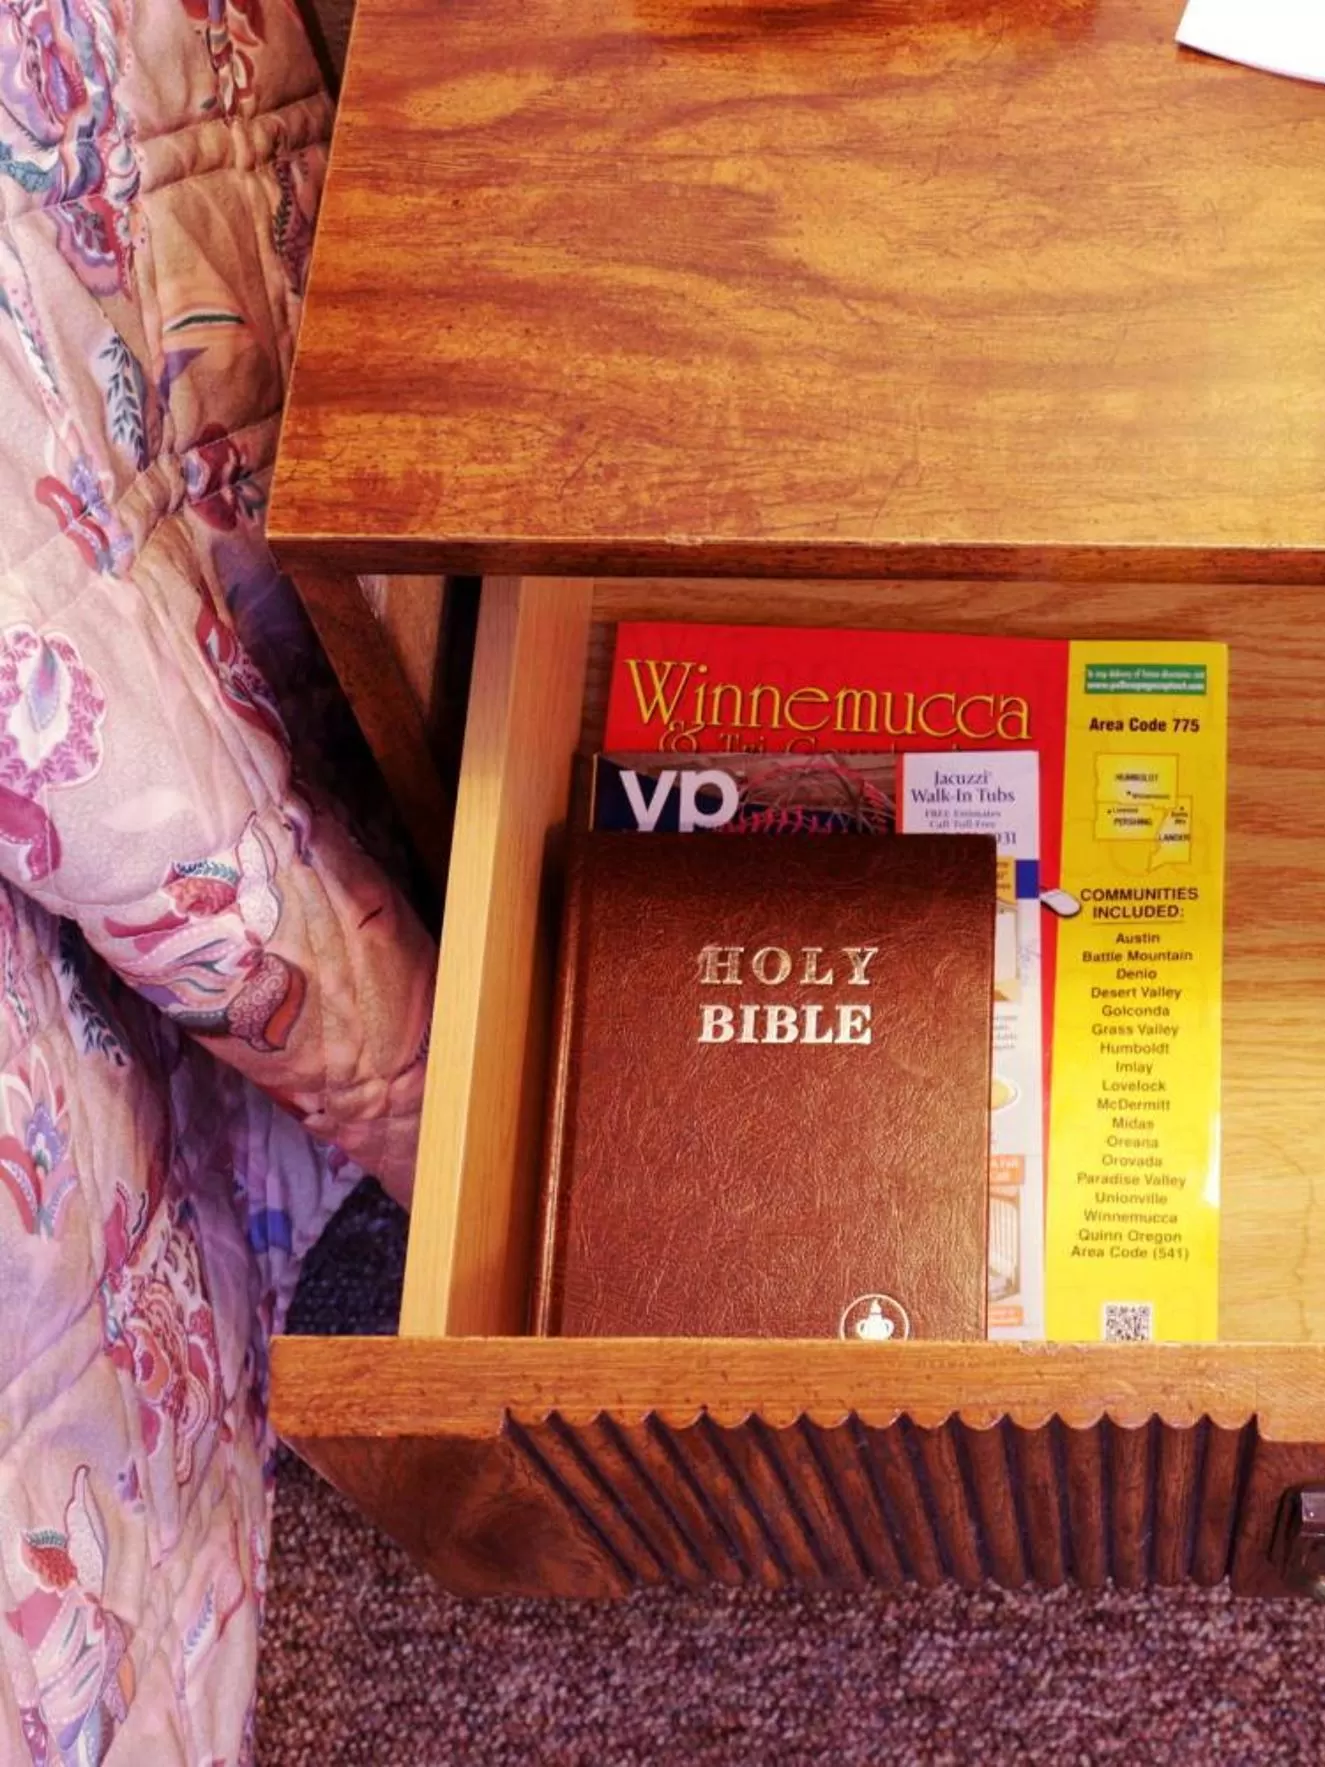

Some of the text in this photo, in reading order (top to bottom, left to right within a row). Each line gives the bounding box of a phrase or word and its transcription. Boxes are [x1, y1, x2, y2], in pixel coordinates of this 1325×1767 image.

[624, 659, 1032, 740] Winnemucca
[1089, 717, 1200, 732] Area Code 775
[934, 769, 988, 786] Jacuzzi
[976, 785, 1016, 803] Tubs
[1080, 888, 1199, 901] COMMUNITIES
[1093, 905, 1185, 919] INCLUDED:
[1115, 932, 1160, 944] Austin
[1082, 950, 1193, 962] Battle Mountain
[698, 946, 878, 985] HOLY
[1116, 968, 1157, 980] Denio
[1091, 986, 1182, 1000] Desert Valley
[1101, 1004, 1170, 1017] Golconda
[698, 1004, 872, 1044] BIBLE
[1091, 1023, 1179, 1038] Grass Valley
[1100, 1042, 1170, 1055] Humboldt
[1115, 1060, 1153, 1075] Imlay
[1101, 1079, 1167, 1092] Lovelock
[1096, 1098, 1171, 1111] McDermitt
[1112, 1116, 1154, 1129] Midas
[1106, 1134, 1159, 1148] Oreana
[1101, 1153, 1163, 1168] Orovada
[1077, 1171, 1186, 1189] Paradise Valley
[1095, 1191, 1168, 1205] Unionville
[1083, 1208, 1178, 1224] Winnemucca
[1078, 1228, 1182, 1244] Quinn Oregon
[1070, 1245, 1190, 1262] Area Code (541)
